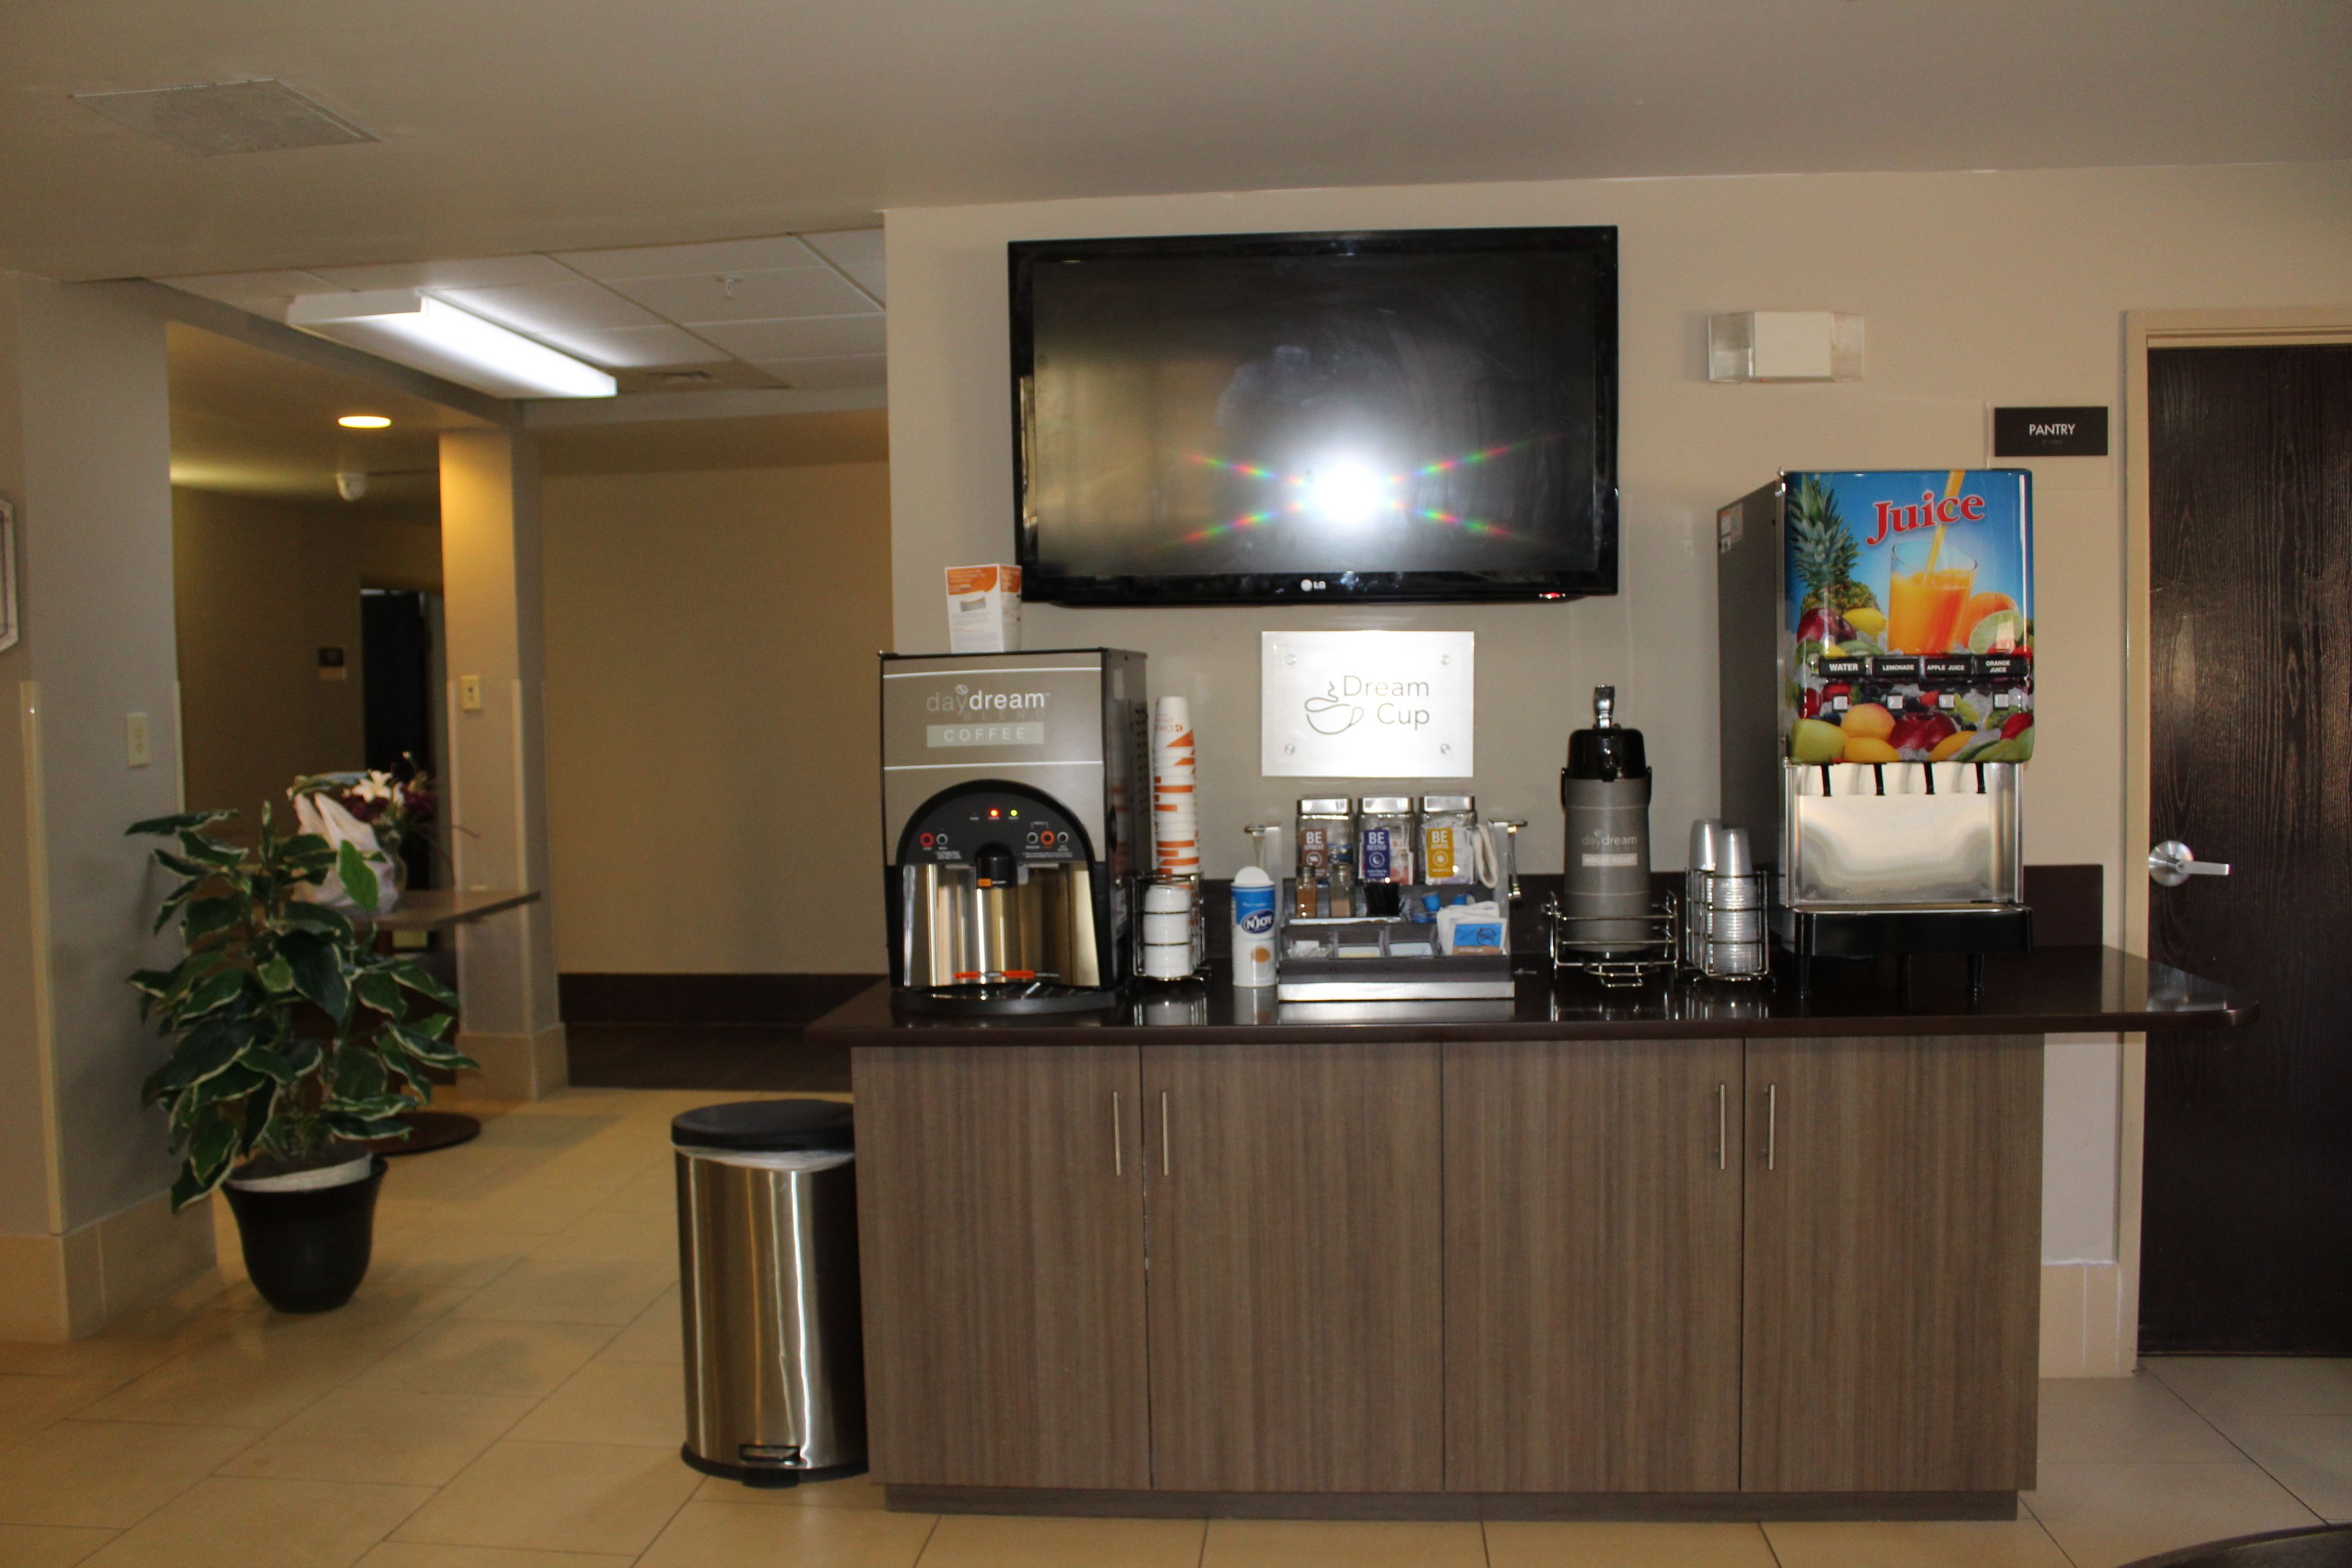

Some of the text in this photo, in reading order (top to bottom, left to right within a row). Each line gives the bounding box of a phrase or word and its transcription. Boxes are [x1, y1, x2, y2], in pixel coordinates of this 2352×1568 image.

[2029, 423, 2076, 436] PANTRY
[1866, 489, 1986, 546] Juice
[1313, 581, 1327, 590] LG
[1828, 663, 1859, 672] WATER
[1343, 675, 1430, 697] Dream
[1376, 703, 1431, 731] Cup
[943, 727, 1027, 742] COFFEE
[1306, 832, 1322, 845] BE
[1368, 832, 1385, 845] BE
[1431, 831, 1447, 843] BE
